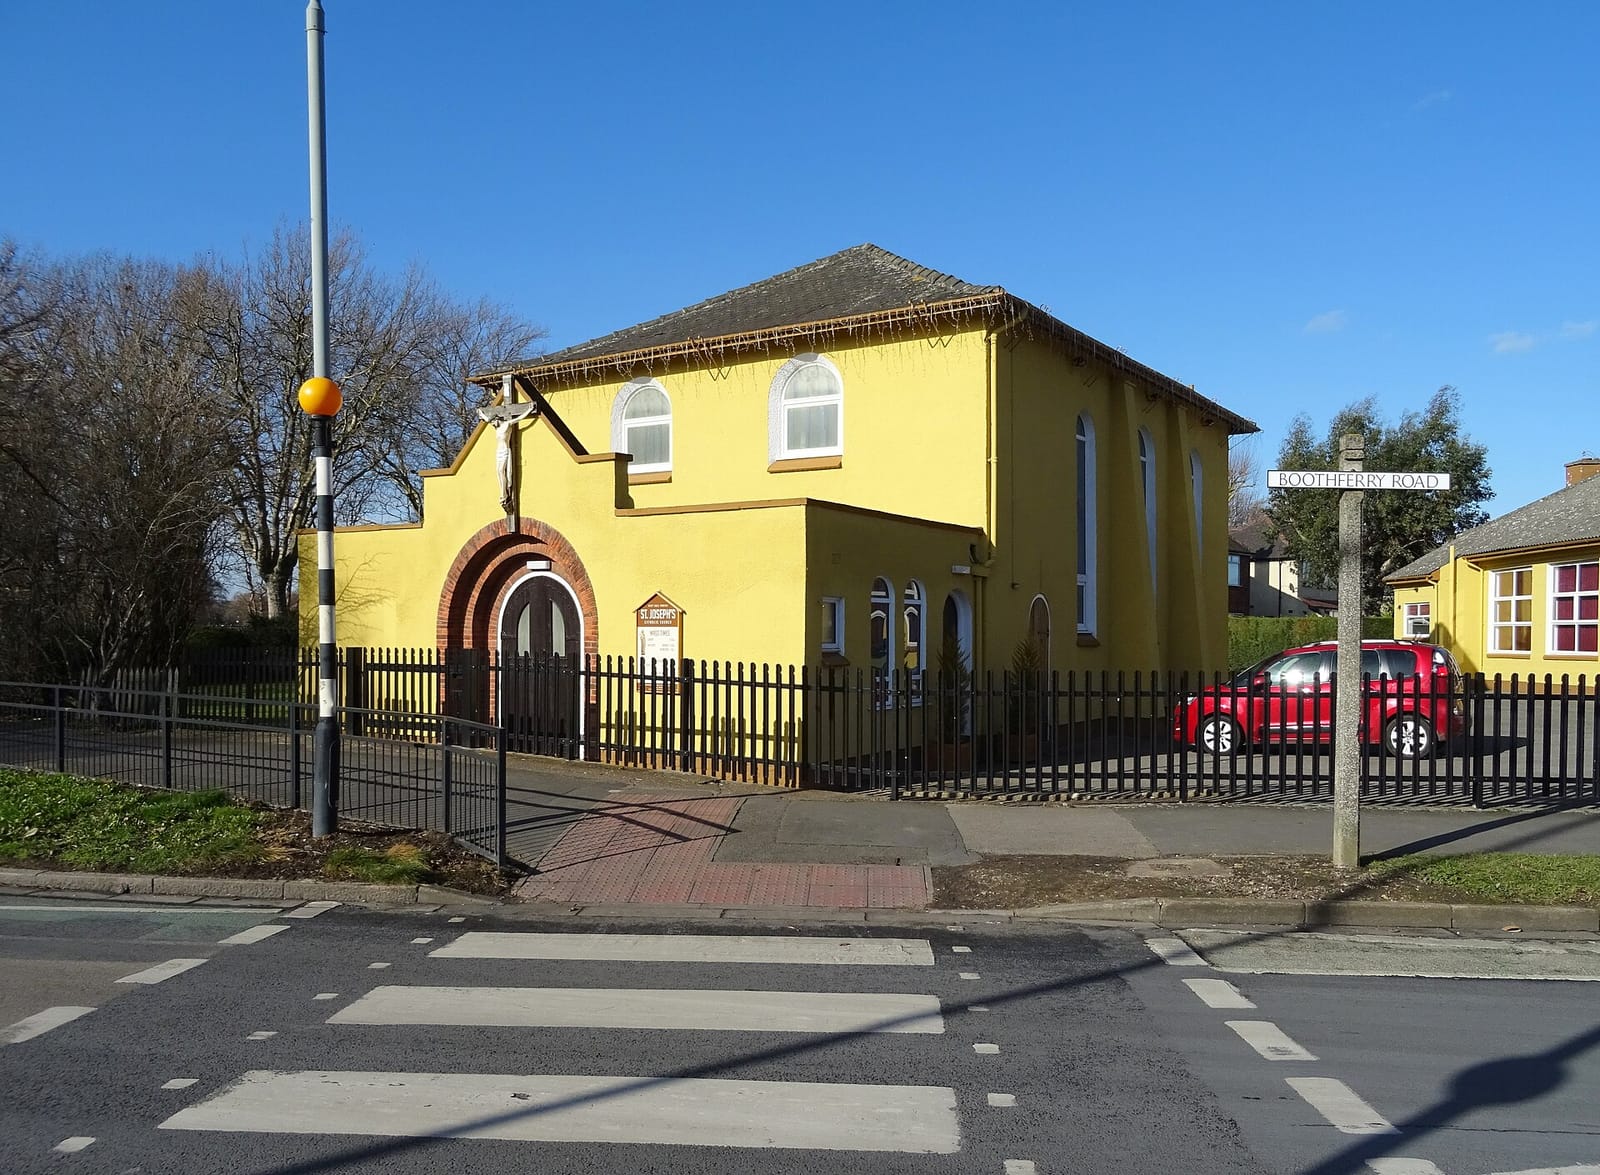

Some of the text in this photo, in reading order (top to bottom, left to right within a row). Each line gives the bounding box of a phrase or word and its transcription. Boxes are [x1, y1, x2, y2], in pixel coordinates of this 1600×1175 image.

[1279, 472, 1439, 488] BOOTHFERRY ROAD
[649, 609, 676, 619] JOSEPH'S
